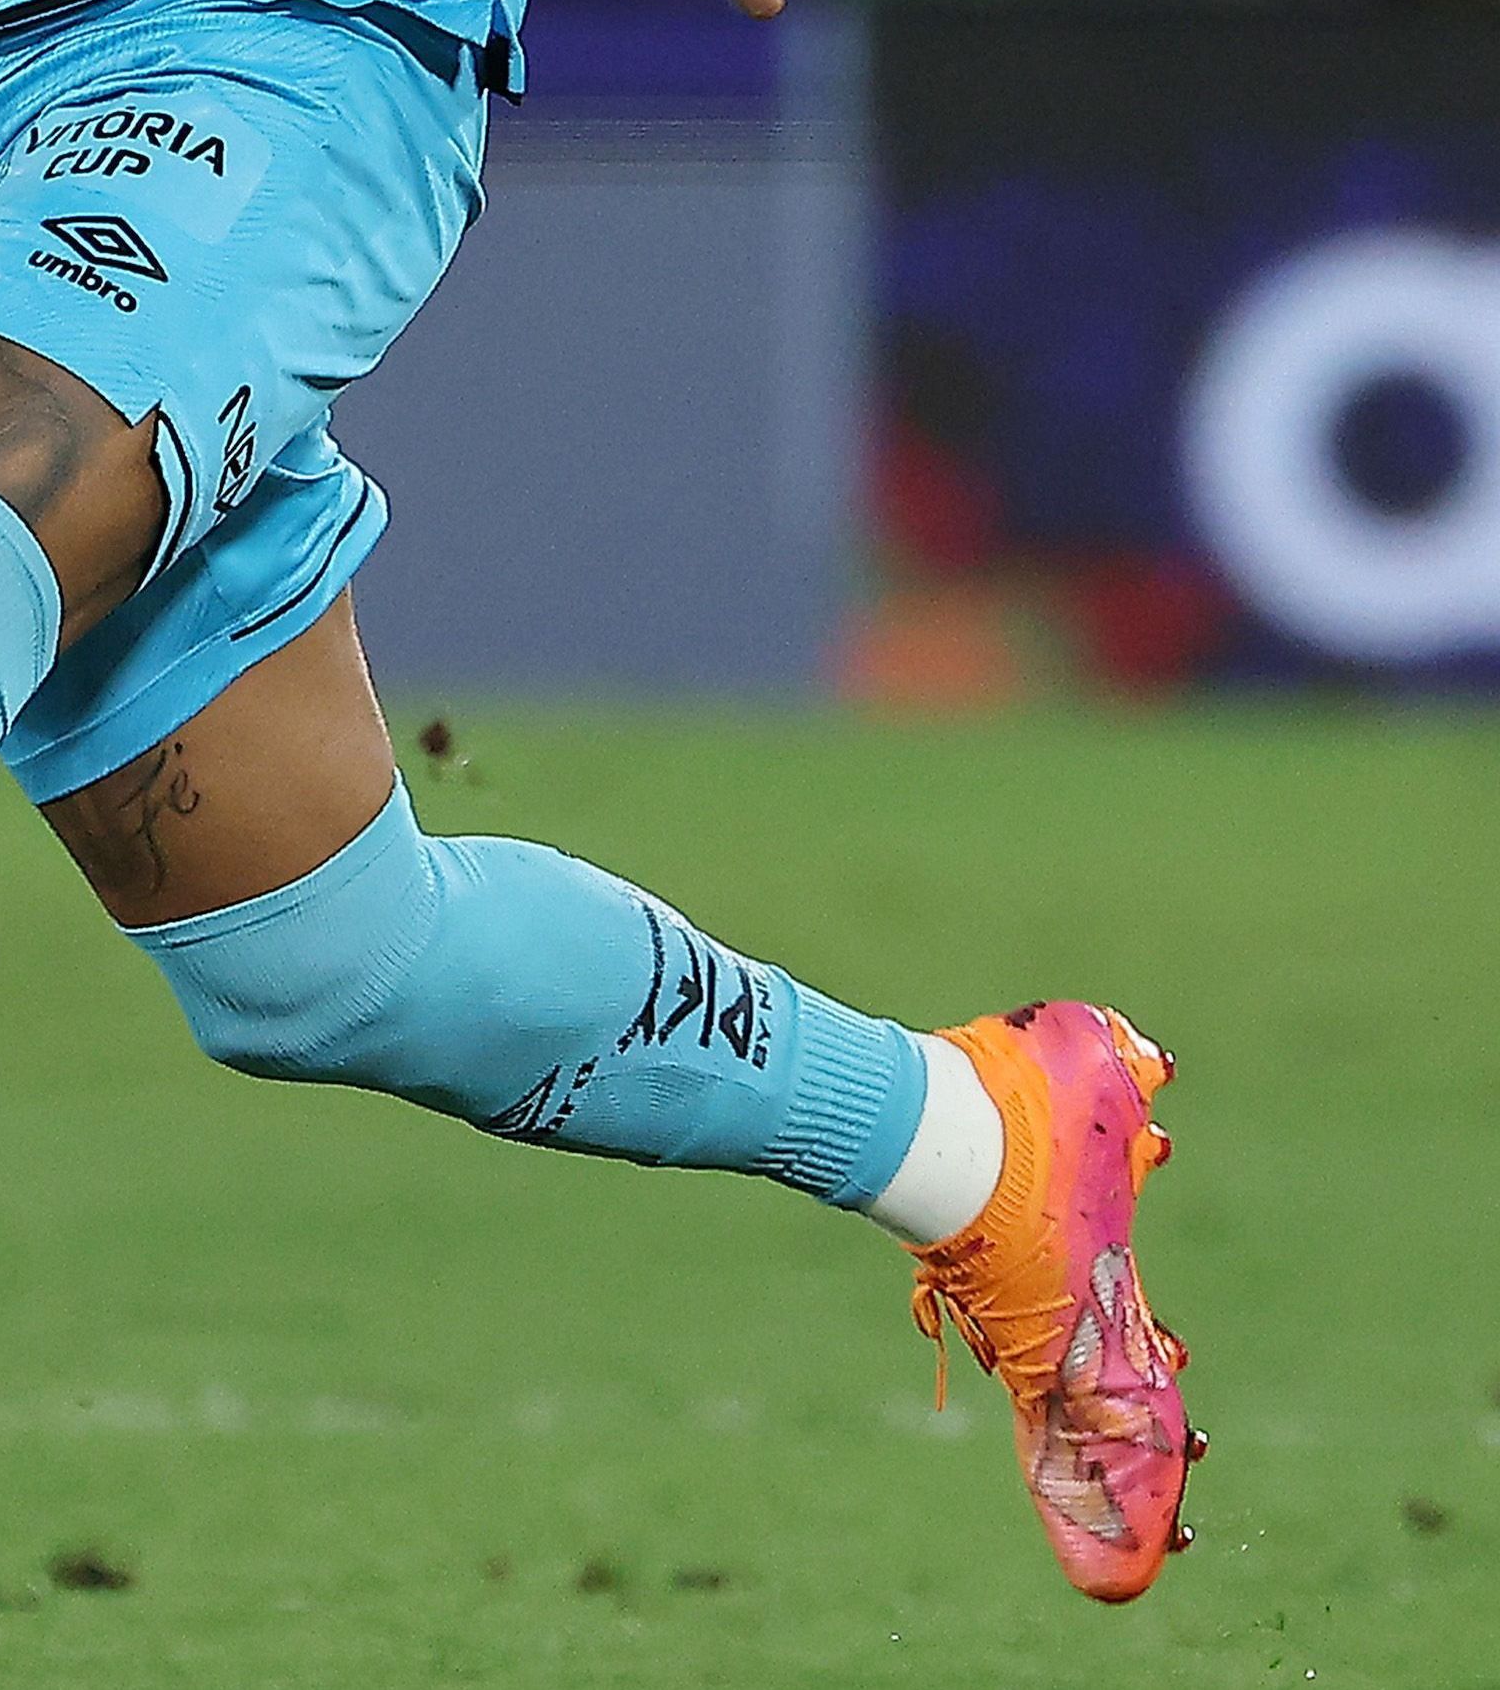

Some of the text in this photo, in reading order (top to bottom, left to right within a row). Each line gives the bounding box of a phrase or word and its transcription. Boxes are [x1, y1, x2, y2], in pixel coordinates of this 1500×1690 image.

[26, 105, 226, 178] VITÓRIA
[43, 146, 152, 181] CUP
[28, 248, 137, 313] umbro
